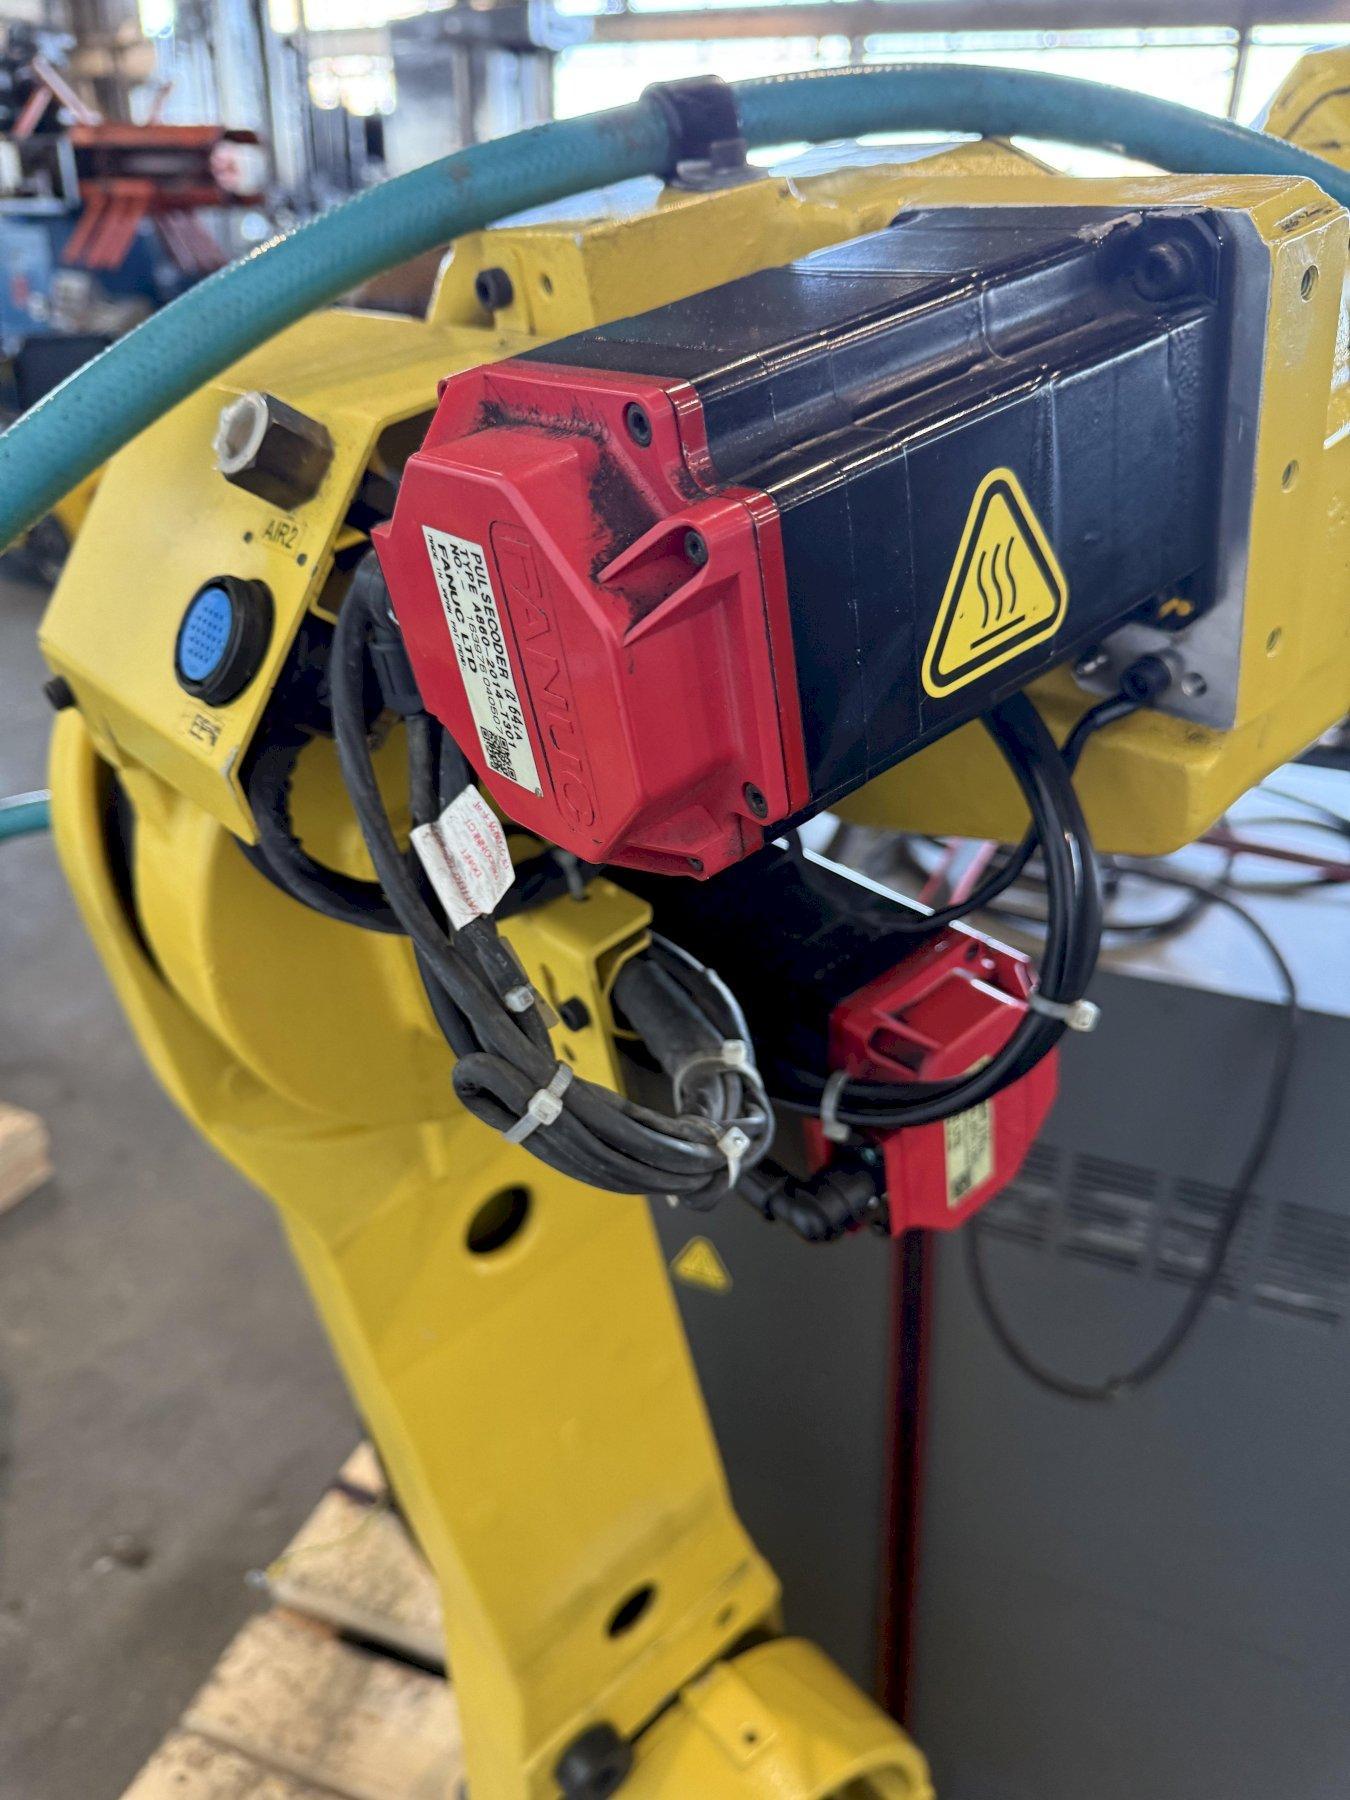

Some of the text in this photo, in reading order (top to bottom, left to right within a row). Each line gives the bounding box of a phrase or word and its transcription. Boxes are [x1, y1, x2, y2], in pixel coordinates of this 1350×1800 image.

[264, 520, 299, 549] AIR2
[438, 543, 478, 674] FANUC LTD
[459, 548, 517, 749] TYPE A860-2014-T301
[471, 551, 509, 680] PULSECODER
[499, 535, 596, 827] FANUC
